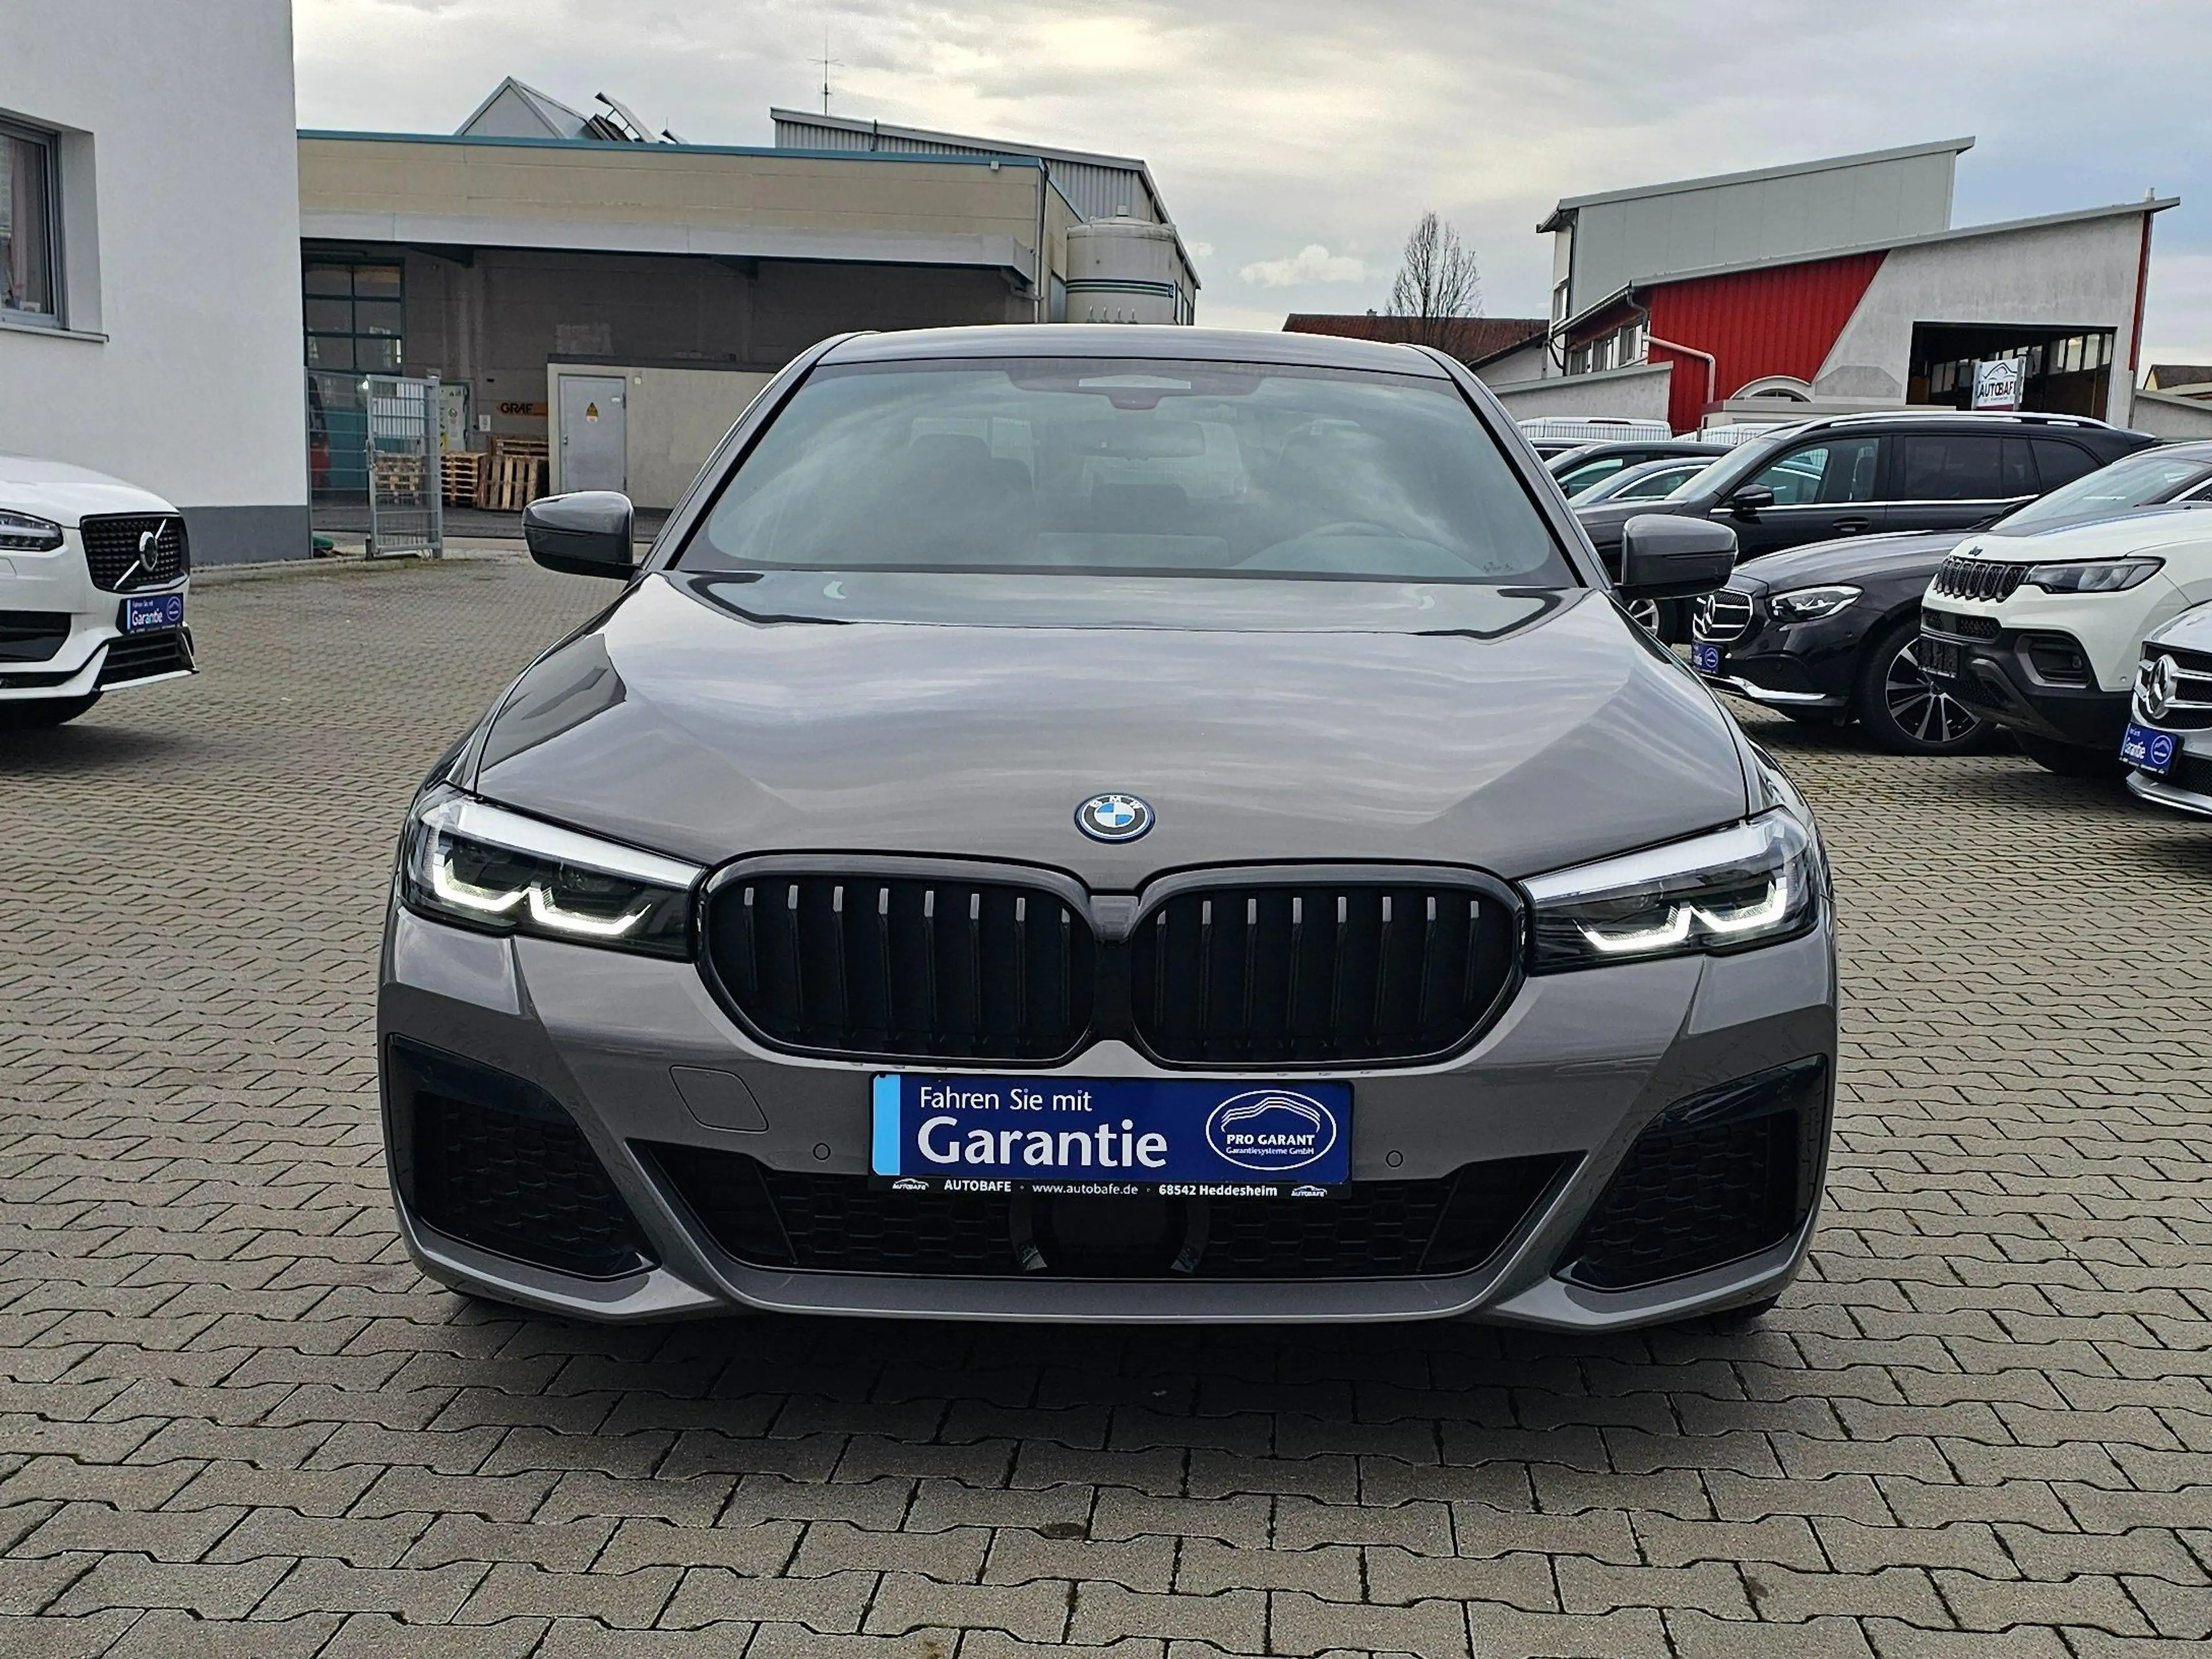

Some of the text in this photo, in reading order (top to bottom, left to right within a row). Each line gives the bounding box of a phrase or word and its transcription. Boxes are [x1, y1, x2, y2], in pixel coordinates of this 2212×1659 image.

[500, 402, 533, 414] GRAF
[1090, 795, 1143, 809] BMW
[921, 1086, 1093, 1112] Fahren Sie mit
[918, 1116, 1168, 1168] Garantie
[1226, 1134, 1316, 1146] PRO GARANT
[1225, 1146, 1315, 1157] Garantiesysteme GmbH
[944, 1179, 1278, 1197] AUTOBAFE www.autobafe.de 68542 Heddesheim
